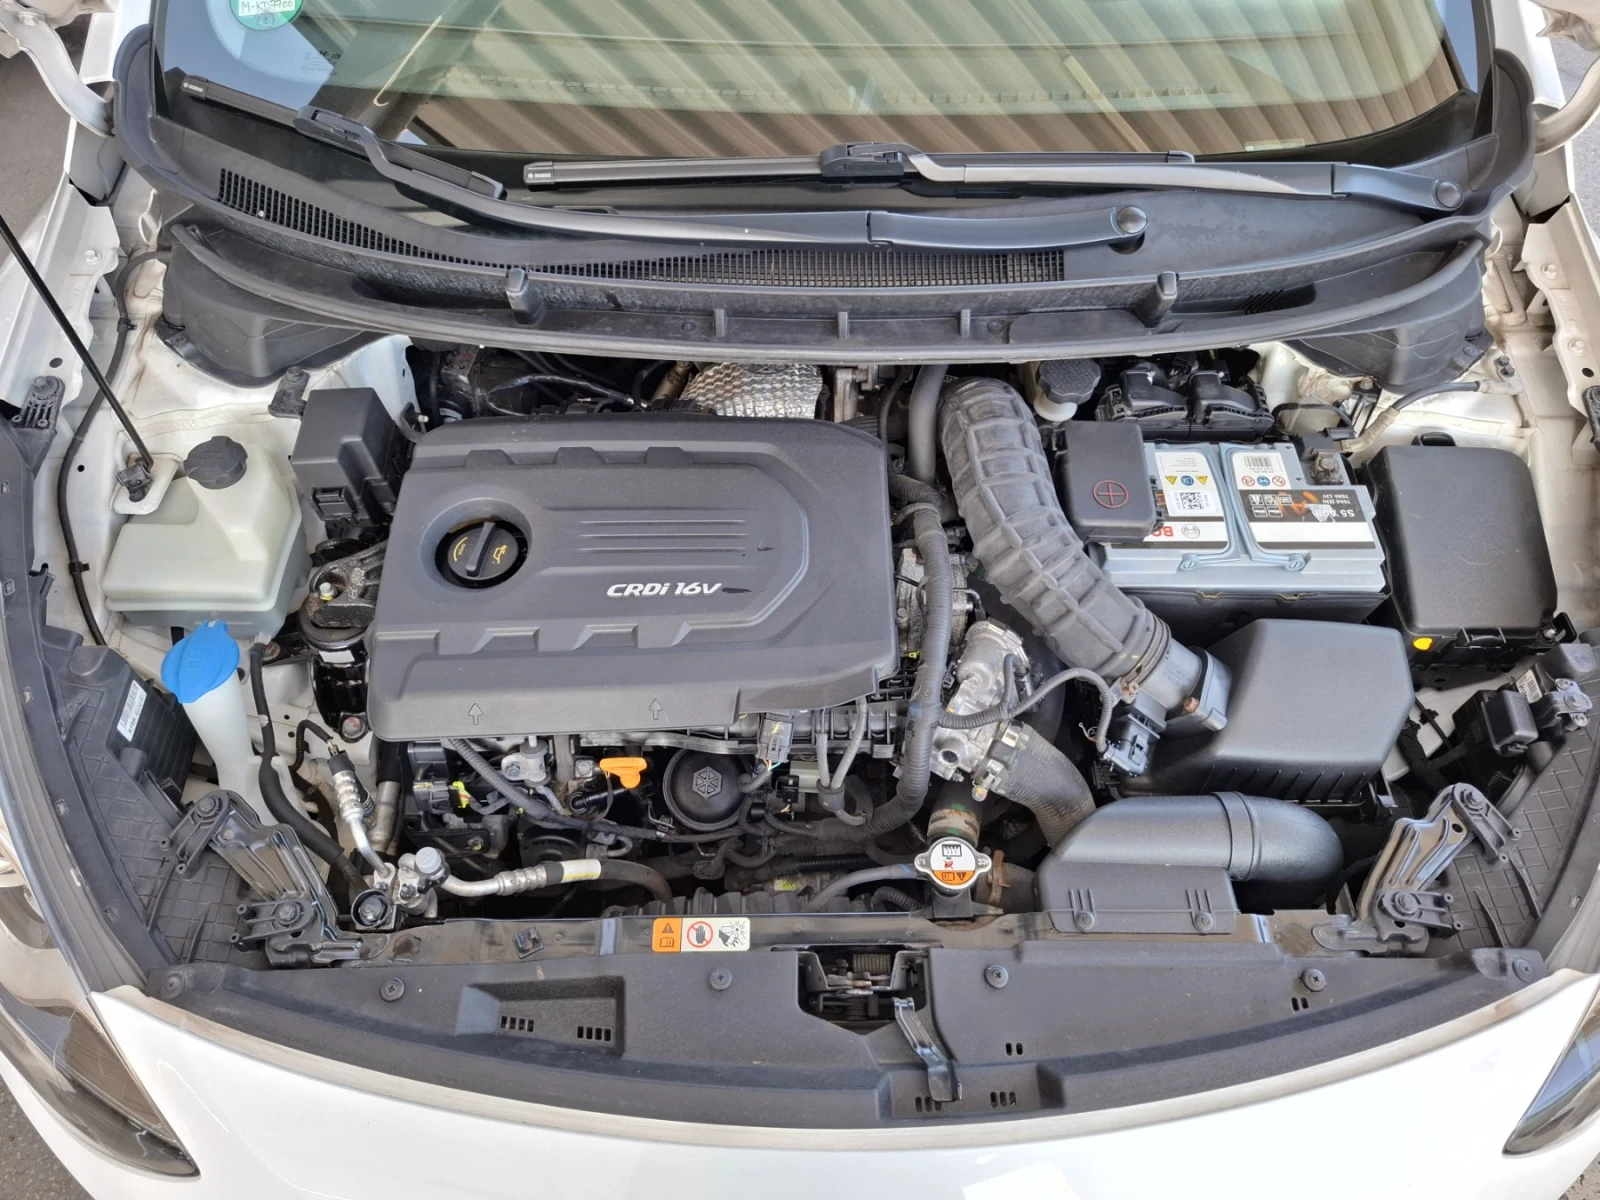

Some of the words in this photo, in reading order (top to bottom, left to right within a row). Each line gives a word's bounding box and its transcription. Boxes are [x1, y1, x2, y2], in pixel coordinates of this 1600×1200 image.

[1340, 509, 1355, 517] S5
[606, 582, 671, 597] CRDi
[674, 581, 723, 595] 16V
